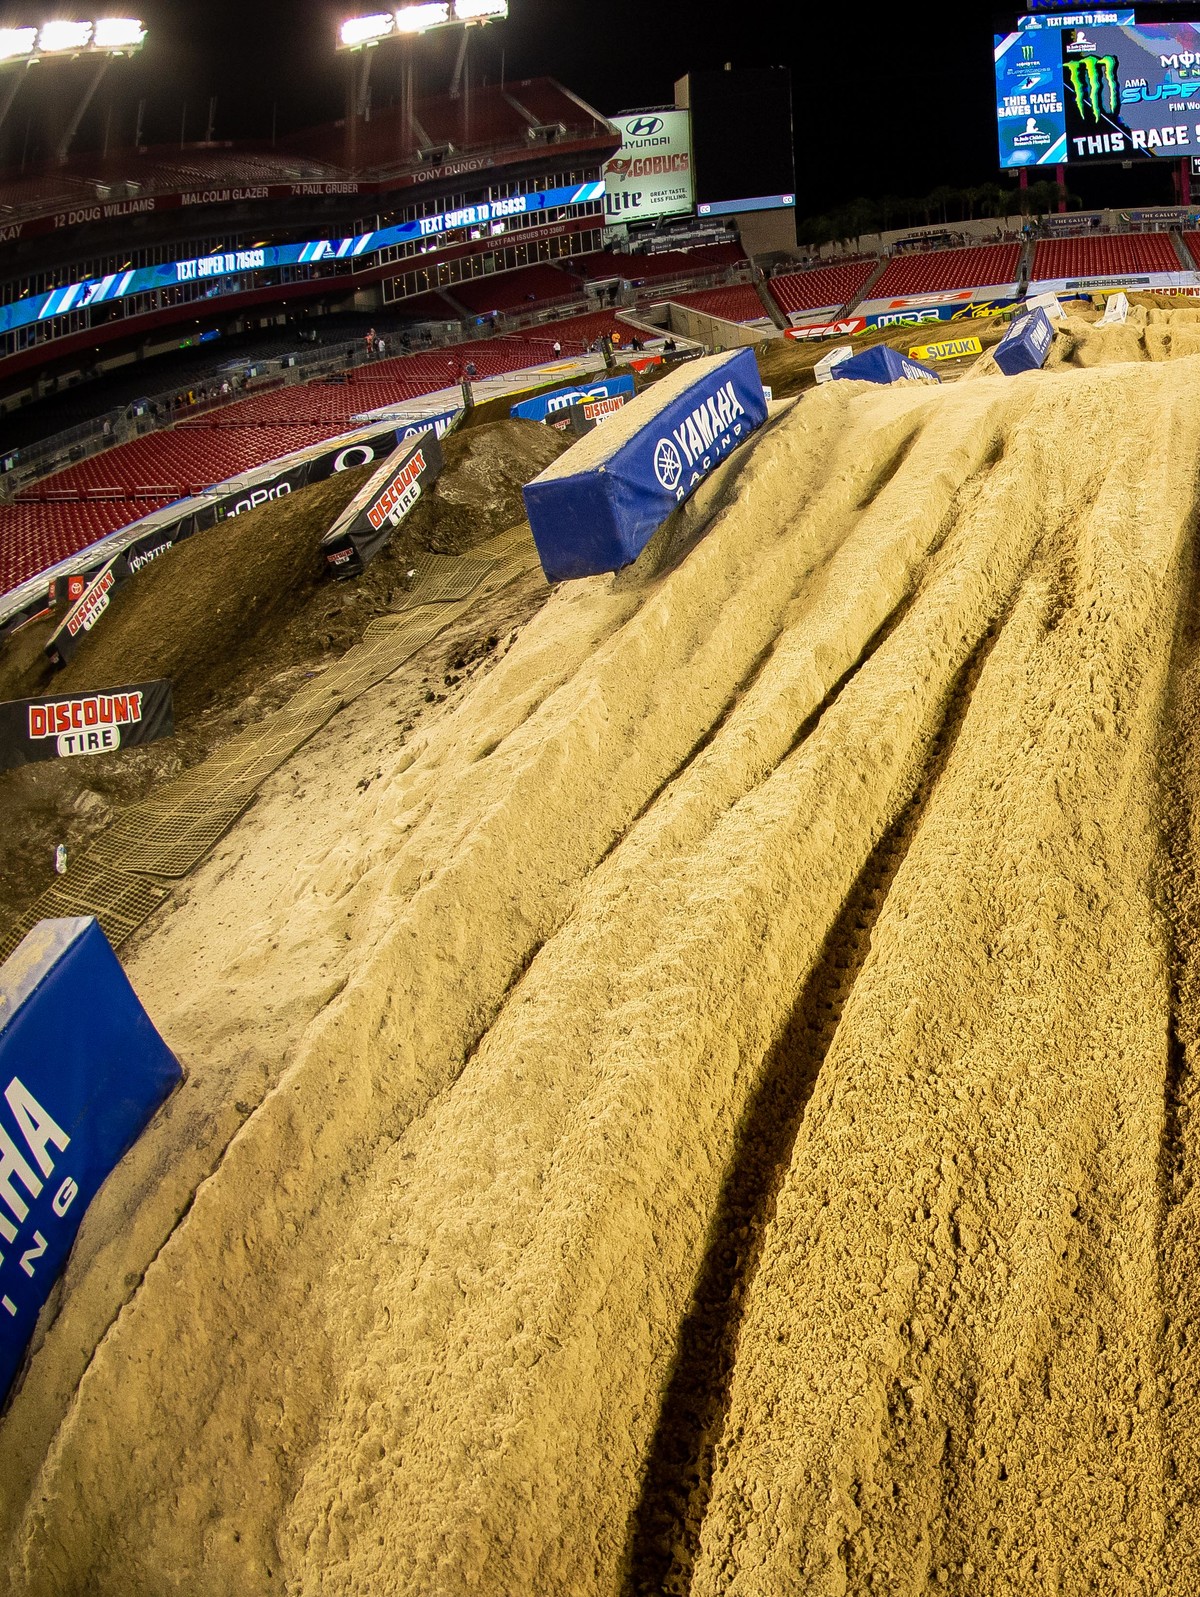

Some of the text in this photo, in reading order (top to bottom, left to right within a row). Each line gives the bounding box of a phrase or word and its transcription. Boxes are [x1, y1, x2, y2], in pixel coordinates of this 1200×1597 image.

[1047, 17, 1062, 26] TEXT
[1063, 16, 1083, 25] SUPER
[1084, 15, 1092, 24] TO
[1125, 78, 1146, 88] AMA
[998, 102, 1062, 117] SAVES LIVES
[1002, 93, 1056, 106] THIS RACE
[1169, 102, 1186, 112] FIM
[621, 137, 670, 150] HYUNDAI
[1073, 132, 1125, 156] THIS
[1132, 126, 1189, 150] RACE
[411, 158, 484, 183] TONY DUNGY
[182, 187, 269, 205] MALCOLM GLAZER
[291, 184, 358, 195] 74 PAUL GRUBER
[650, 190, 668, 198] GREAT
[54, 198, 155, 228] 12 DOUG WILLIAMS
[605, 191, 642, 216] Lite
[419, 216, 444, 235] TEXT
[445, 208, 476, 229] SUPER
[477, 204, 489, 220] TO
[486, 240, 502, 248] TEXT
[503, 236, 516, 244] FAN
[516, 232, 538, 241] ISSUES
[176, 260, 197, 280] TEXT
[198, 257, 224, 276] SUPER
[225, 254, 235, 271] TO
[926, 340, 976, 360] SUZUKI
[584, 396, 624, 420] DISCOUNT
[673, 381, 744, 468] YAMAHA
[676, 423, 742, 501] RACING
[368, 450, 426, 529] DISCOUNT
[392, 487, 418, 520] TIRE
[68, 570, 115, 636] DISCOUNT
[87, 598, 107, 625] TIRE
[30, 692, 142, 738] DISCOUNT
[64, 730, 113, 754] TIRE
